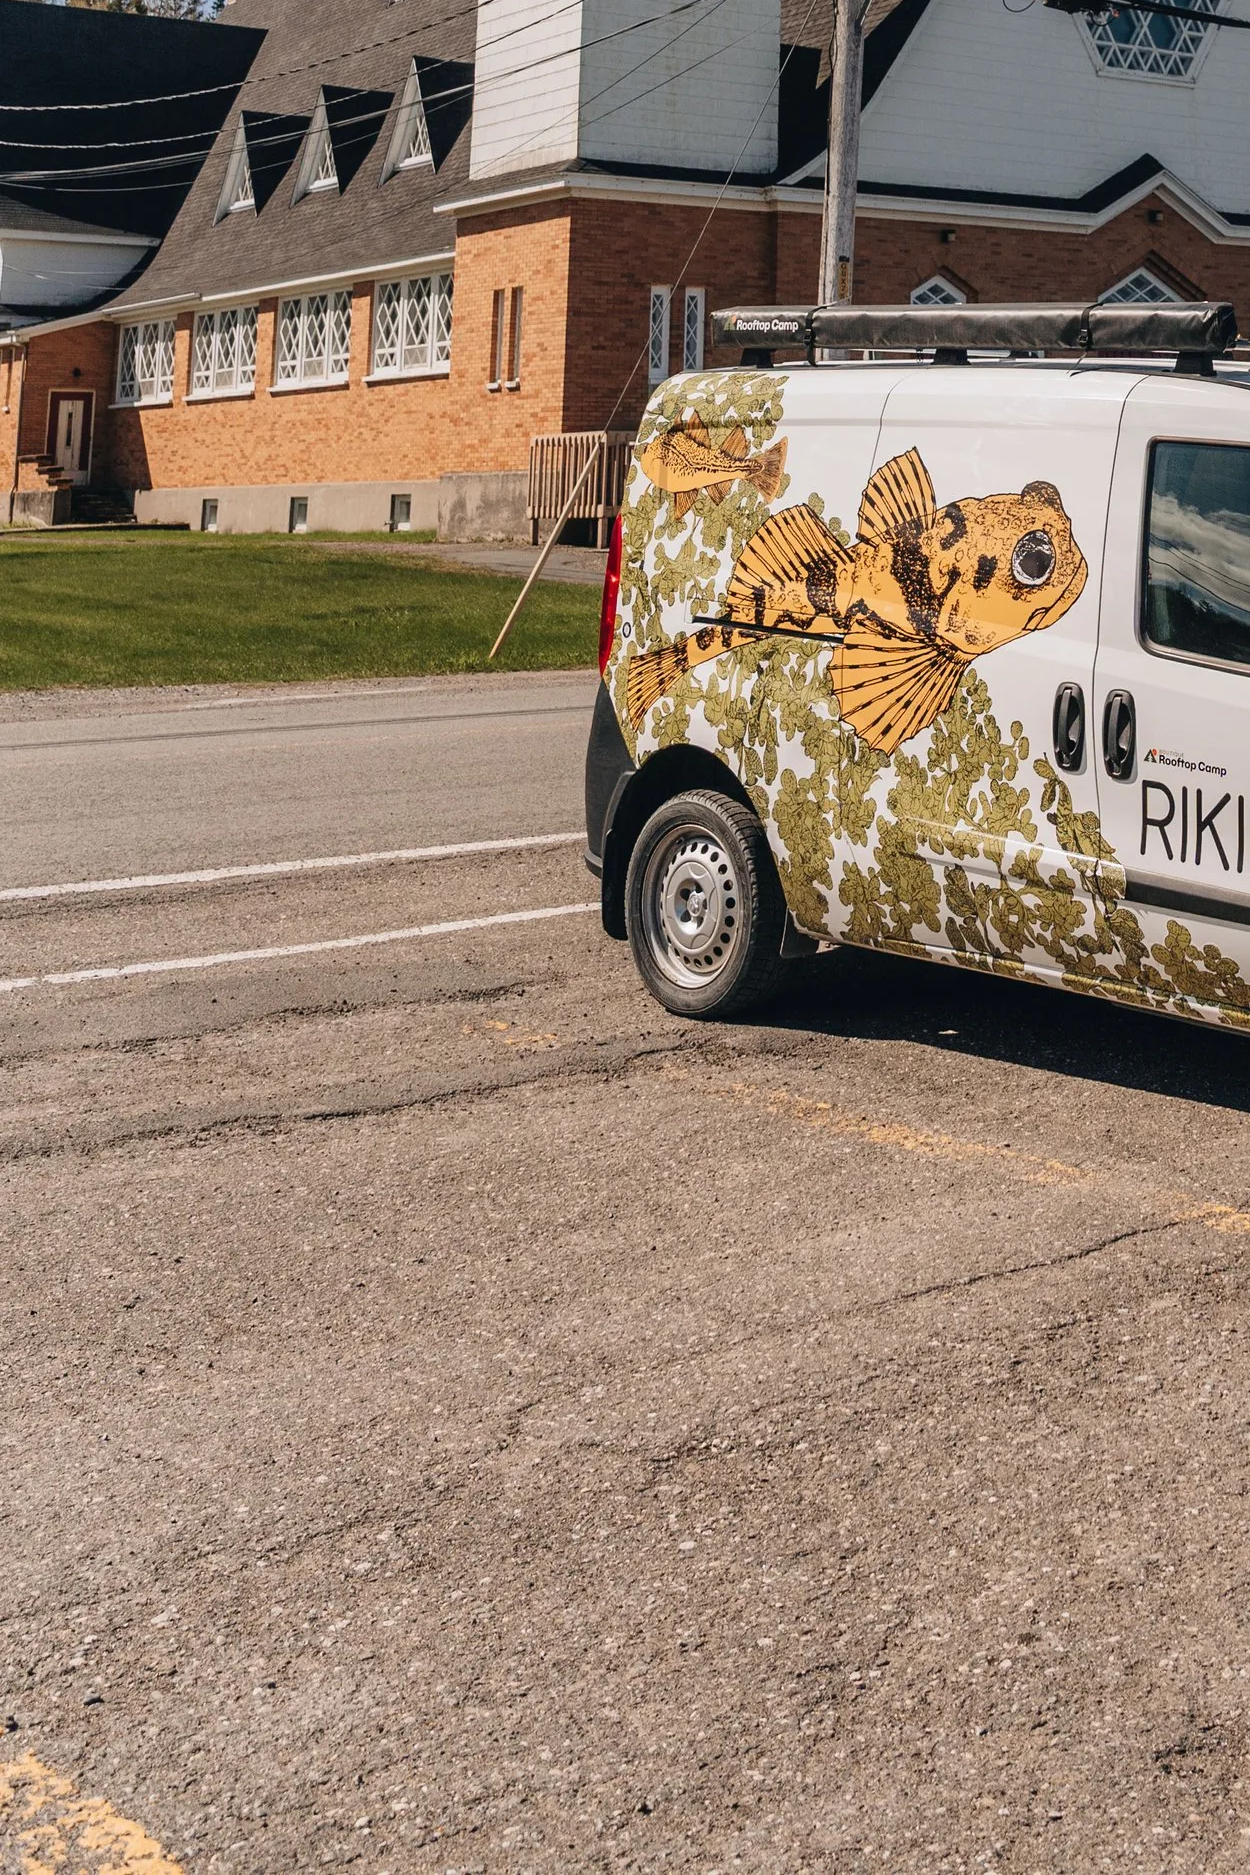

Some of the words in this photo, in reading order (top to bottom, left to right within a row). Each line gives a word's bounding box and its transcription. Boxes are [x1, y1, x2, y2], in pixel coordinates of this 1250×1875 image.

[736, 319, 770, 332] Rooftop
[771, 319, 799, 332] Camp
[1158, 754, 1197, 772] Rooftop
[1198, 761, 1227, 778] Camp
